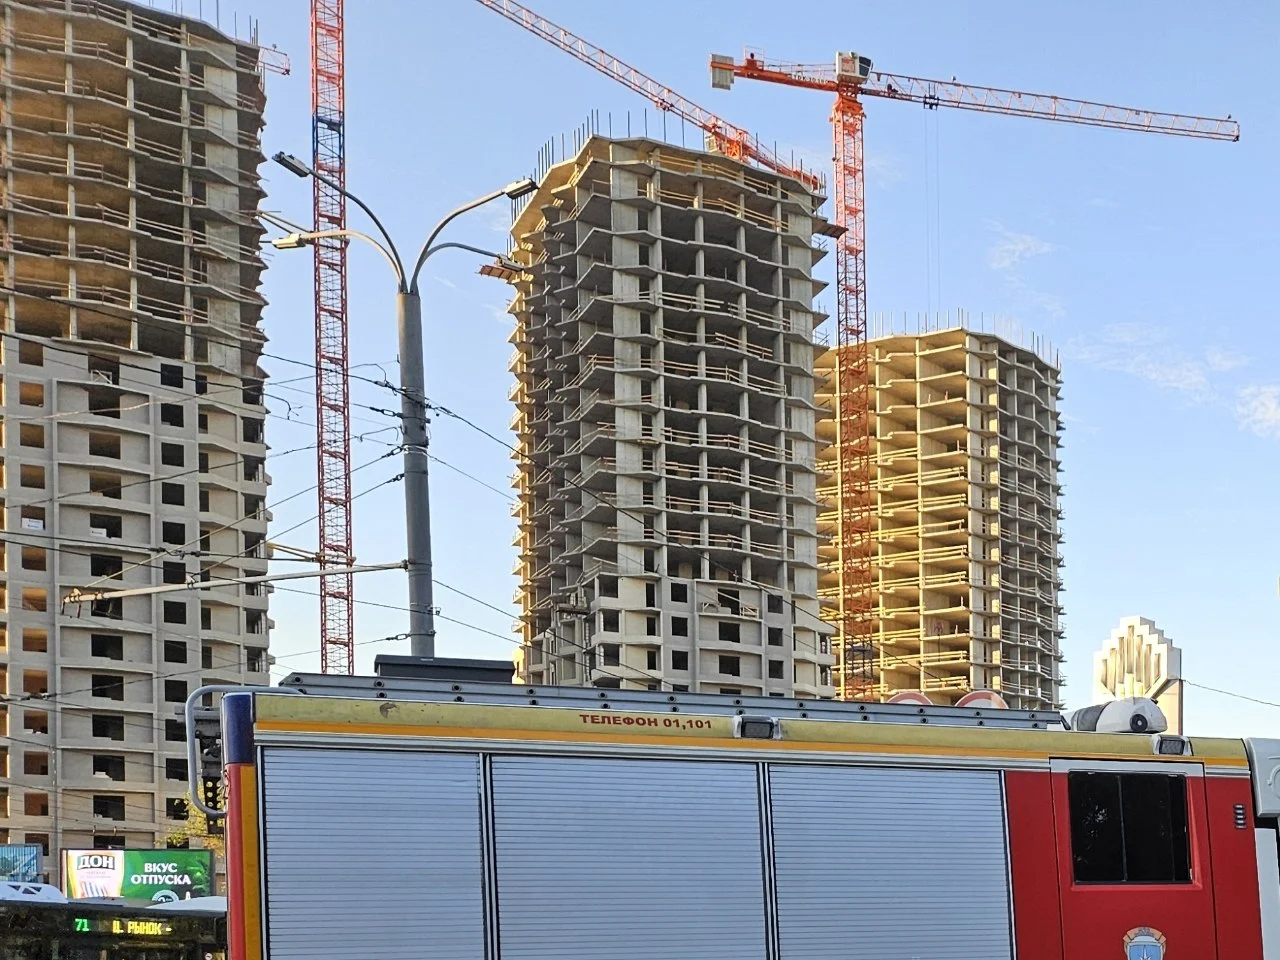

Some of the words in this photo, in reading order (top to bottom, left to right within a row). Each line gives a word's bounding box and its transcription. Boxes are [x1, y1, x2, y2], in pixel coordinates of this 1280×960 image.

[579, 714, 658, 727] ТЕЛЕФОН
[663, 718, 712, 730] 01,101
[78, 855, 115, 869] ДОН
[144, 862, 178, 873] ВКУС
[130, 874, 192, 885] ОТПУСКА
[74, 918, 90, 932] 71
[127, 920, 163, 935] РЫНОК
